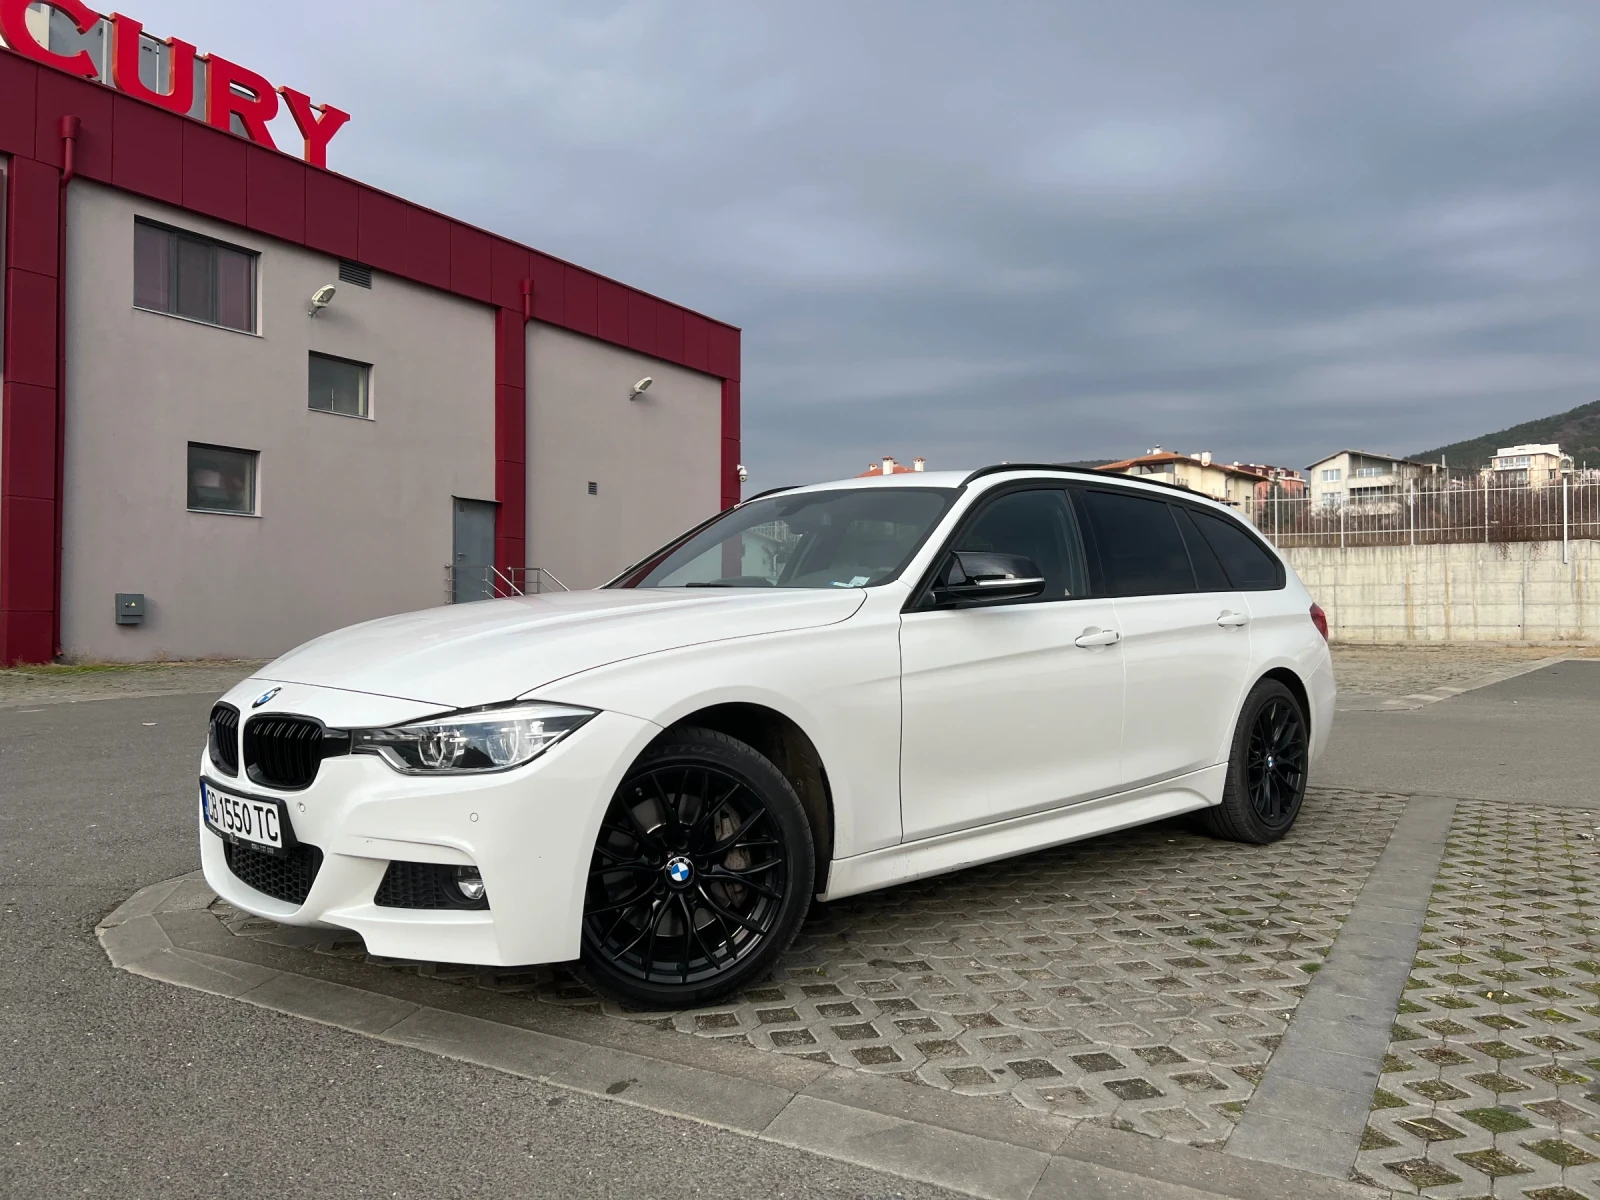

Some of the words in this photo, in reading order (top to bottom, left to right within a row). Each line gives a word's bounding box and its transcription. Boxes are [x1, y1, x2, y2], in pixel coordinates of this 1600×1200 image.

[207, 789, 219, 823] CB
[219, 796, 252, 836] 1550
[253, 804, 279, 842] TC
